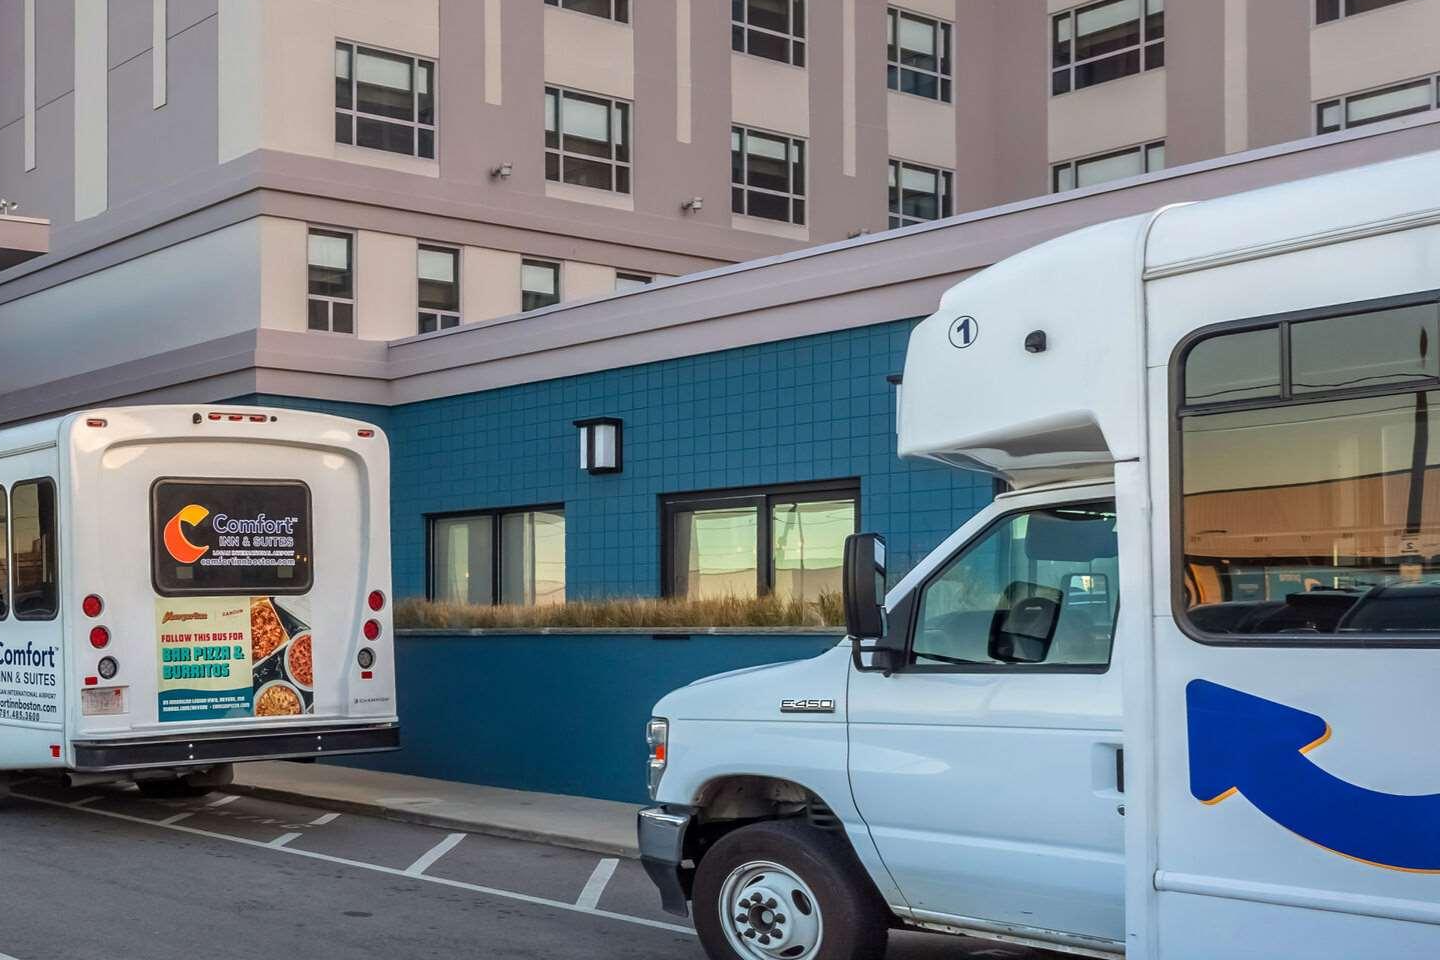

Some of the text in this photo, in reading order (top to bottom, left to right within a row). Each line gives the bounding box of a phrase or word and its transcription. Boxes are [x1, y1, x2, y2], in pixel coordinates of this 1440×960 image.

[956, 318, 970, 344] 1
[212, 513, 295, 534] Comfort
[219, 536, 294, 547] INN & SUITES
[200, 556, 296, 566] comfortinnboston.com
[161, 632, 244, 643] FOLLOW THIS BUS FOR
[162, 645, 245, 662] BAR PIZZA &
[15, 671, 21, 683] &
[23, 672, 56, 686] SUITES
[163, 663, 230, 679] BURRITOS
